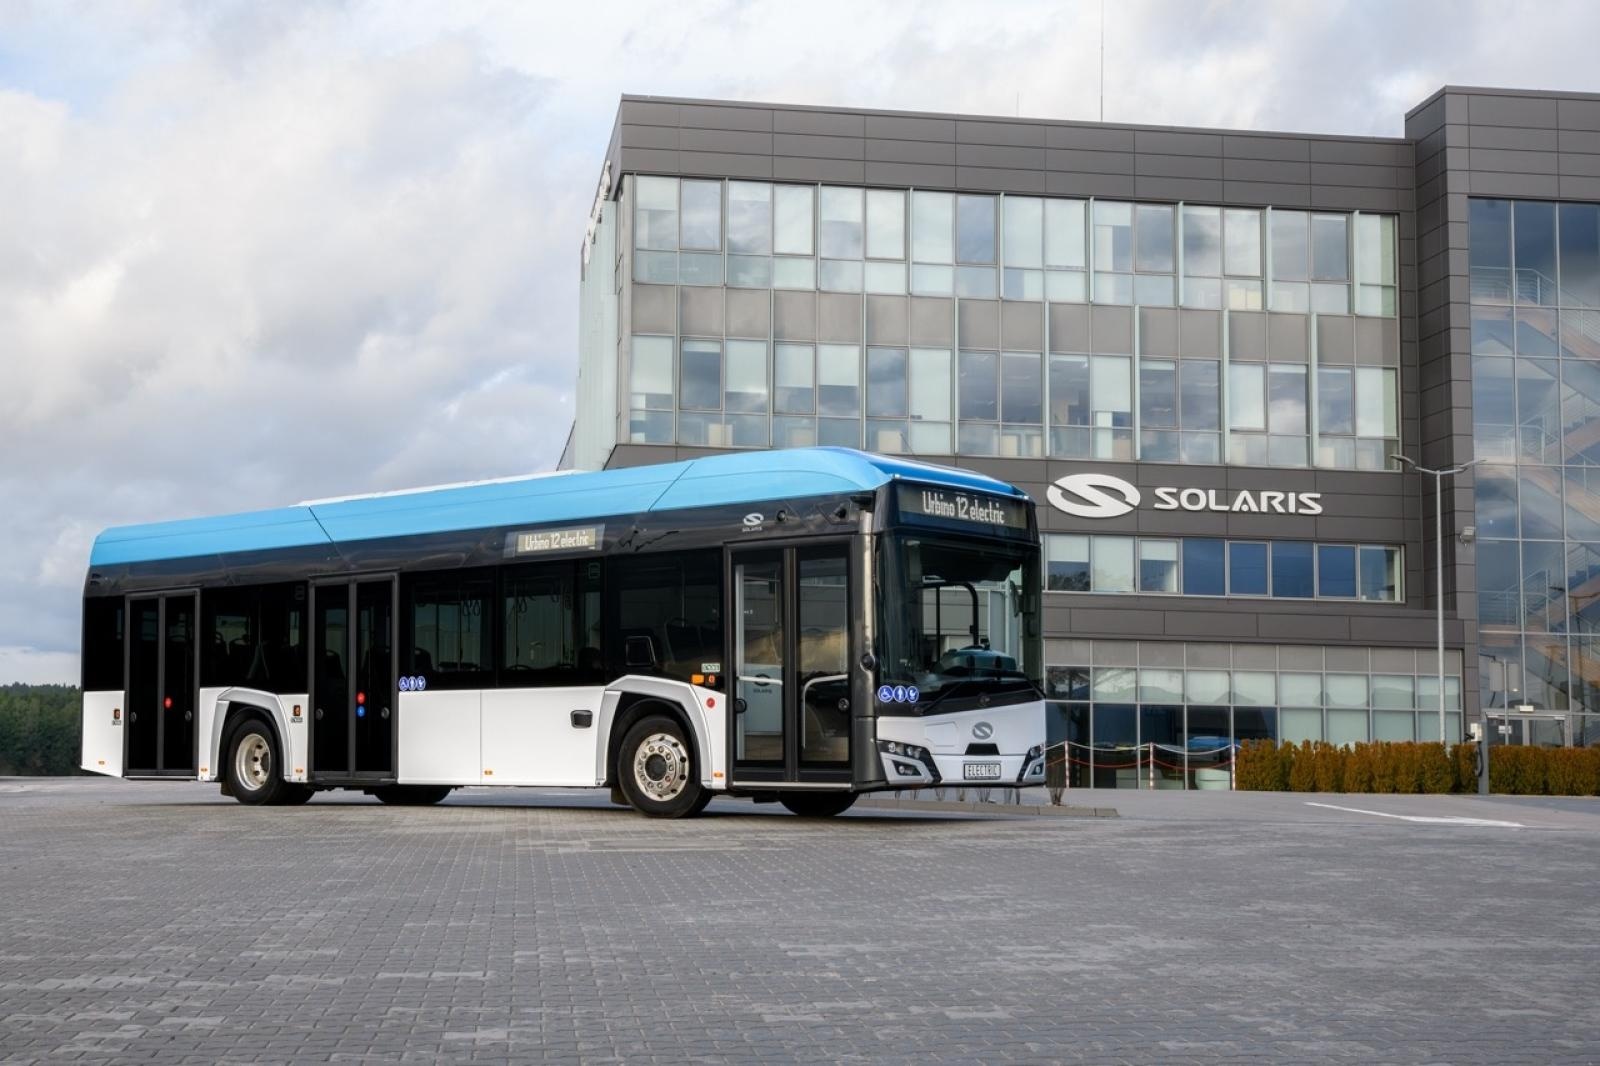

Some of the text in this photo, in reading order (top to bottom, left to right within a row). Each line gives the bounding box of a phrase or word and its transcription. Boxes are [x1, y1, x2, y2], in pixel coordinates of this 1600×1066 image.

[922, 491, 1005, 524] Urbino 12 electric
[1153, 487, 1323, 515] SOLARIS
[525, 530, 589, 551] Urbino 12 electric
[968, 764, 998, 776] ELECTRIC
